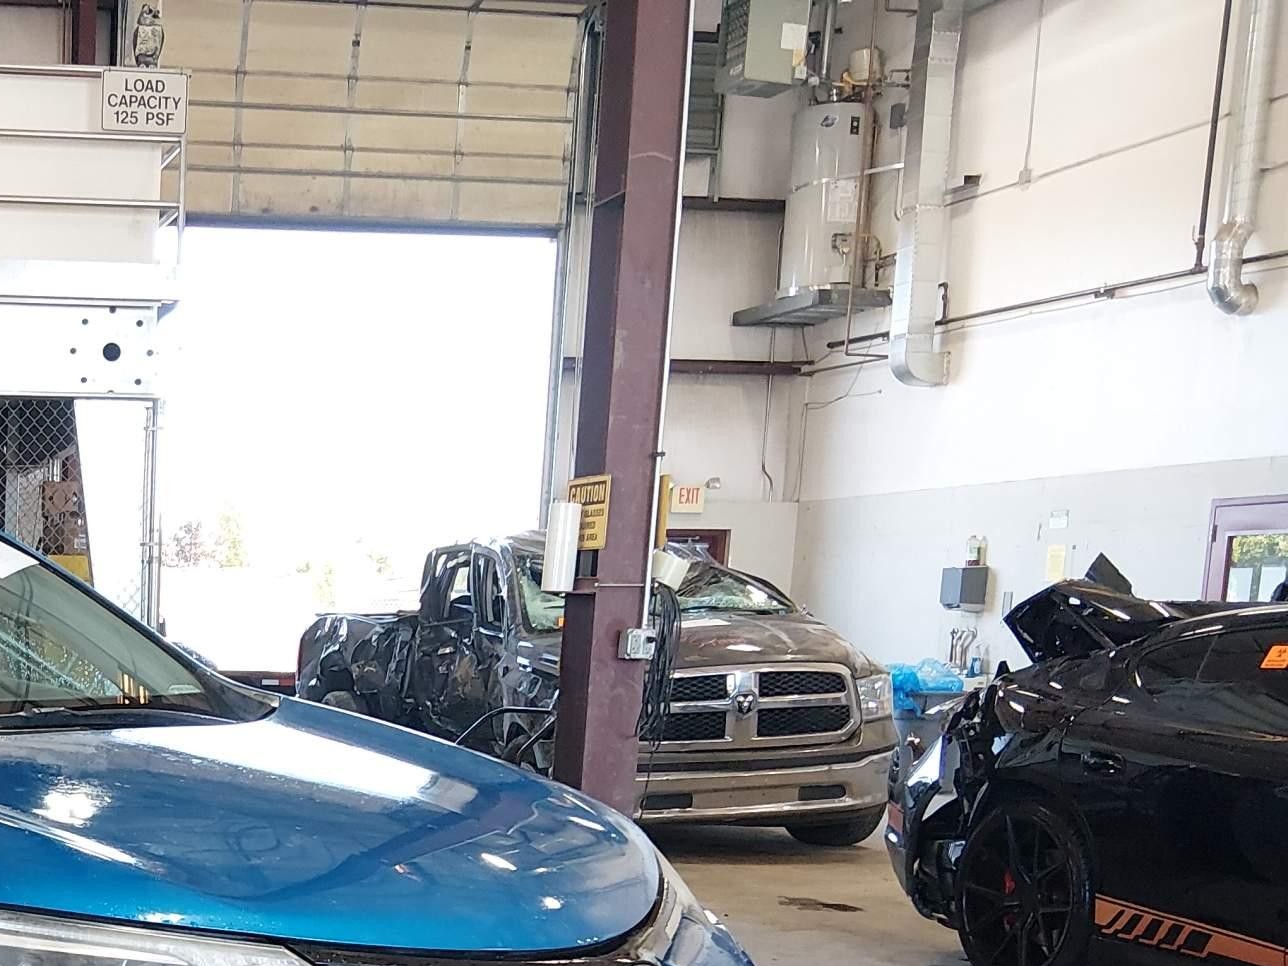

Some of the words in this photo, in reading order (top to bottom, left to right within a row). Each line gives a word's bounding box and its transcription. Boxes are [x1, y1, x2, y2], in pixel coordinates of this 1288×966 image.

[124, 78, 166, 93] LOAD
[107, 93, 182, 110] CAPACITY
[114, 110, 139, 125] 125
[145, 112, 175, 126] PSF
[570, 483, 606, 504] CAUTION
[678, 487, 701, 505] EXIT
